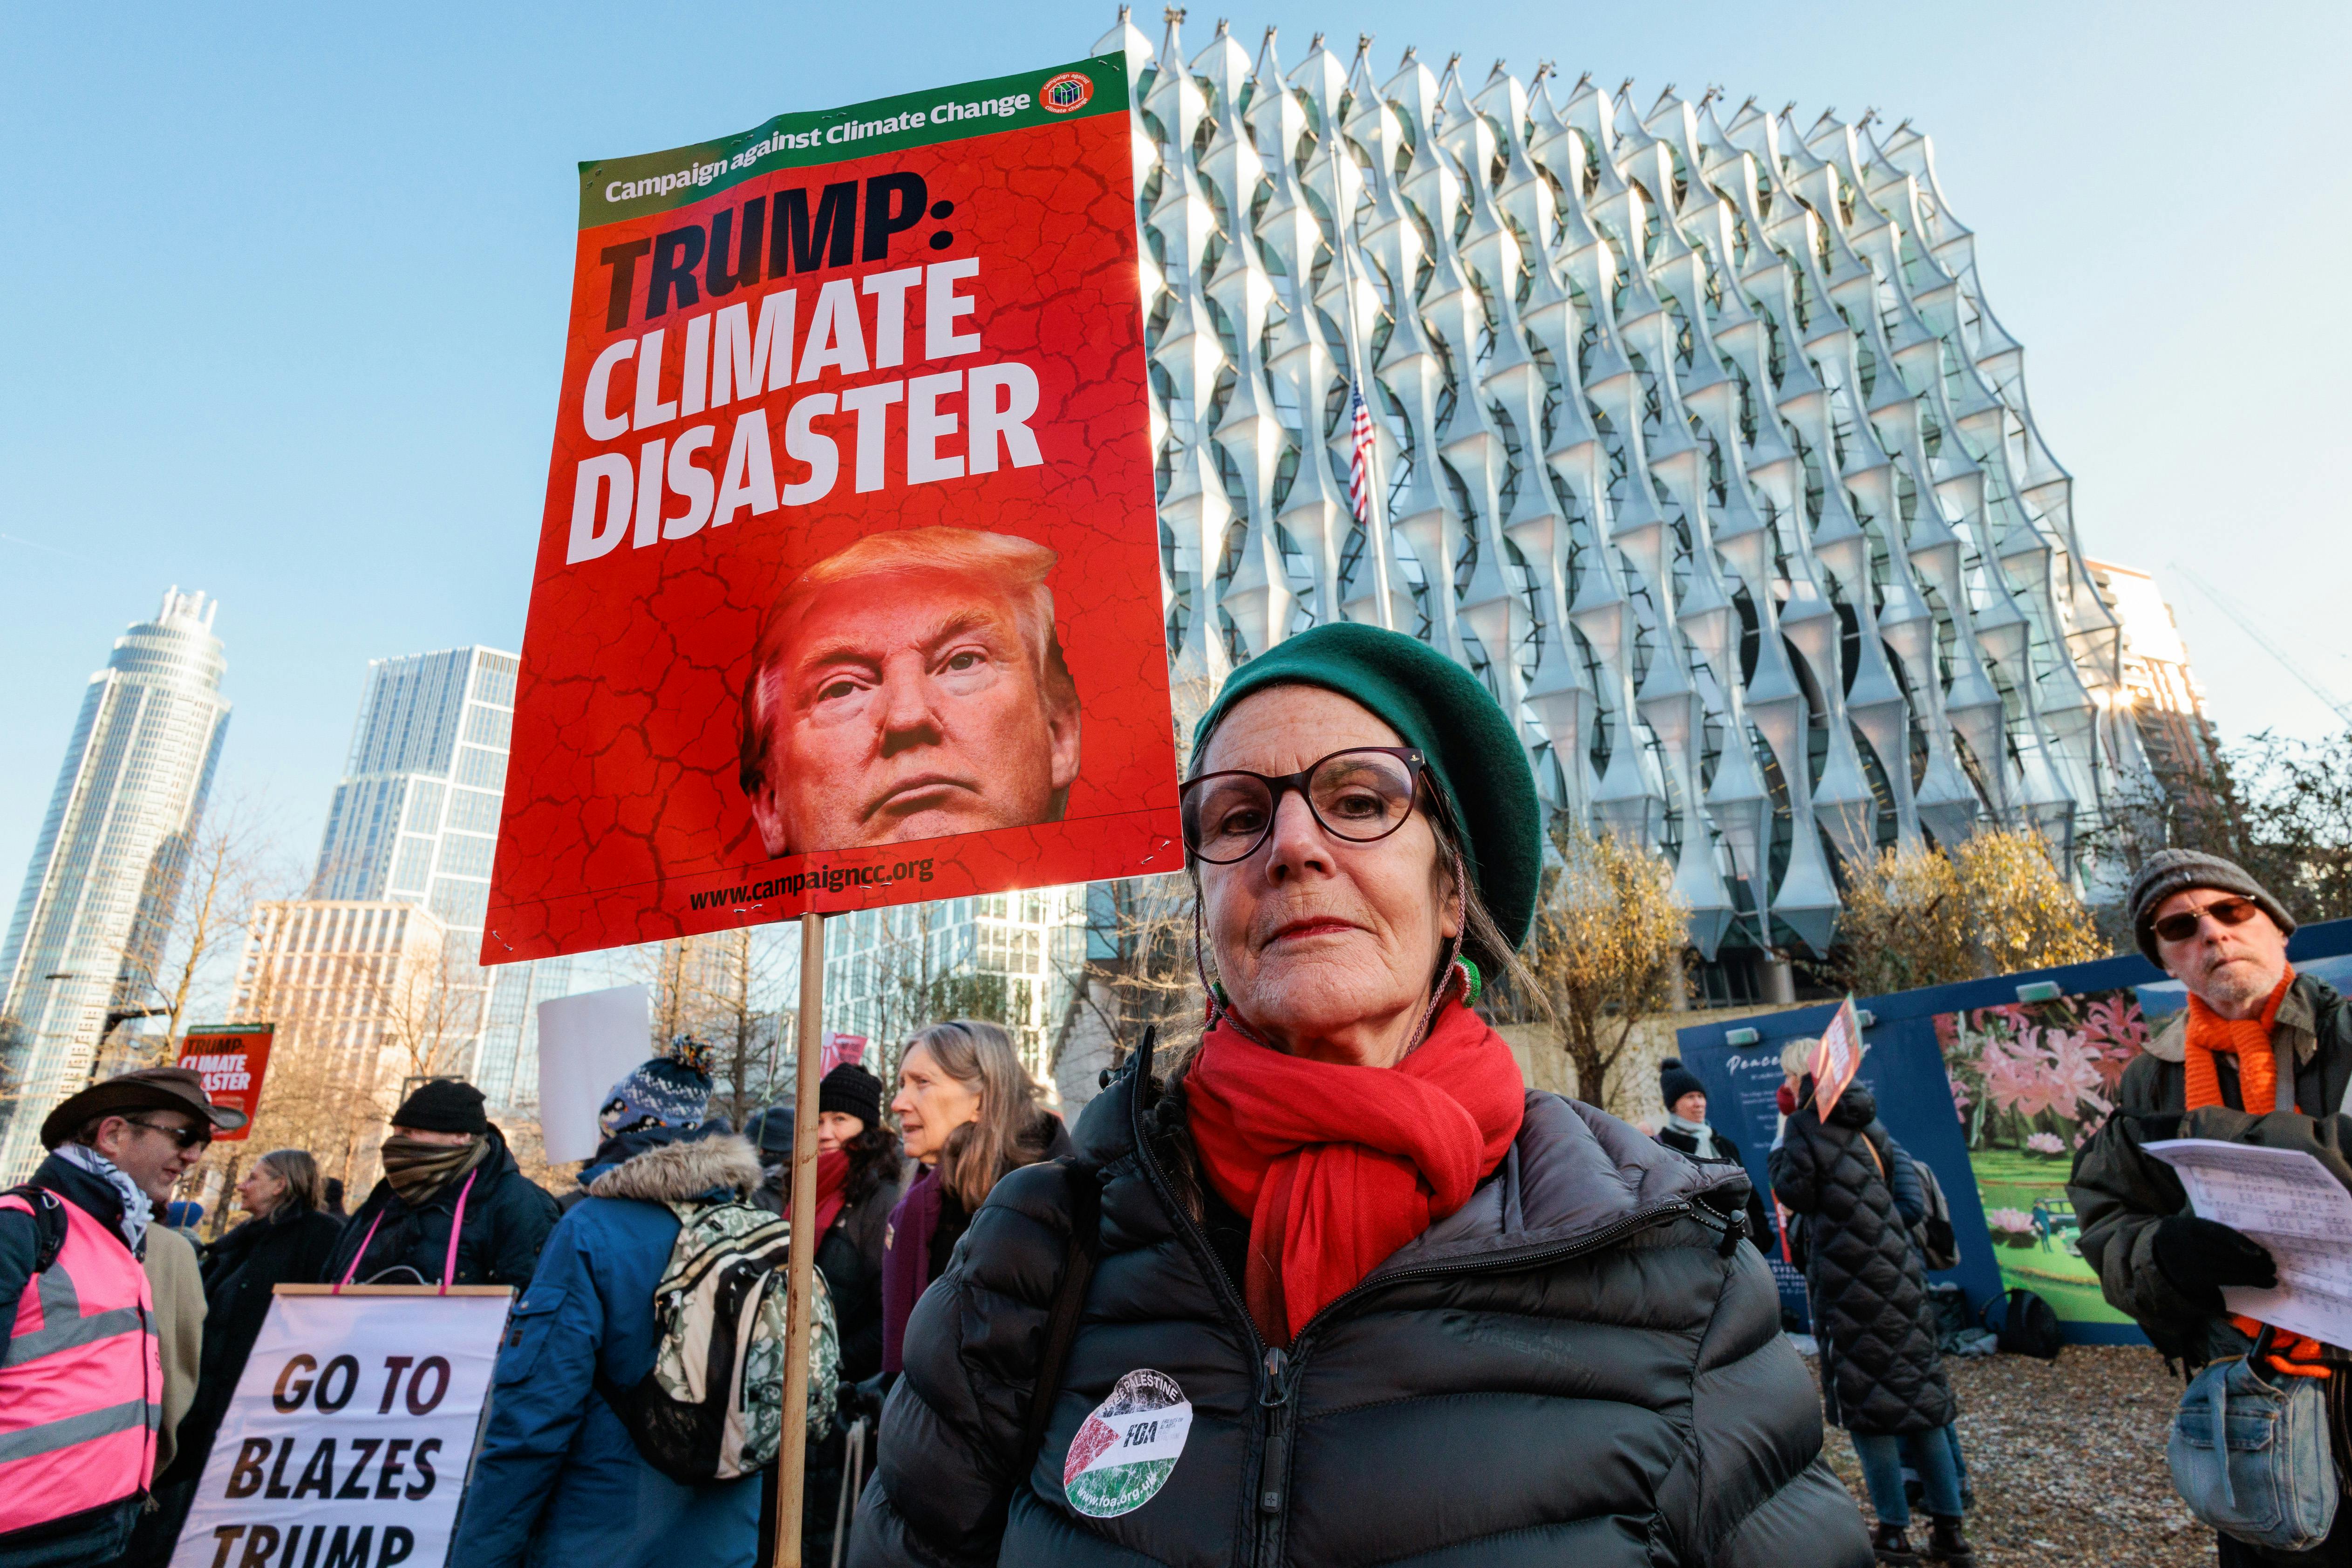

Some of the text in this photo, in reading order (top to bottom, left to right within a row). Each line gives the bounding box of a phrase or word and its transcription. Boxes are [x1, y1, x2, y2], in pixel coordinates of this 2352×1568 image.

[1043, 74, 1090, 90] campaign against
[1068, 97, 1088, 111] change
[605, 92, 1031, 202] Campaign against Climate Change
[600, 170, 954, 333] TRUMP:
[582, 256, 981, 442] CLIMATE
[566, 361, 1044, 565] DISASTER
[689, 857, 934, 911] www.campaigncc.org
[180, 1054, 248, 1073] CLIMATE
[187, 1038, 245, 1054] TRUMP:
[201, 1072, 251, 1091] ASTER
[272, 1353, 451, 1416] GO TO
[1124, 1374, 1178, 1402] PALESTINE
[1123, 1420, 1158, 1448] FOA
[224, 1437, 443, 1501] BLAZES
[1077, 1473, 1157, 1507] www.foa.org.uk
[211, 1525, 415, 1568] TRUMP
